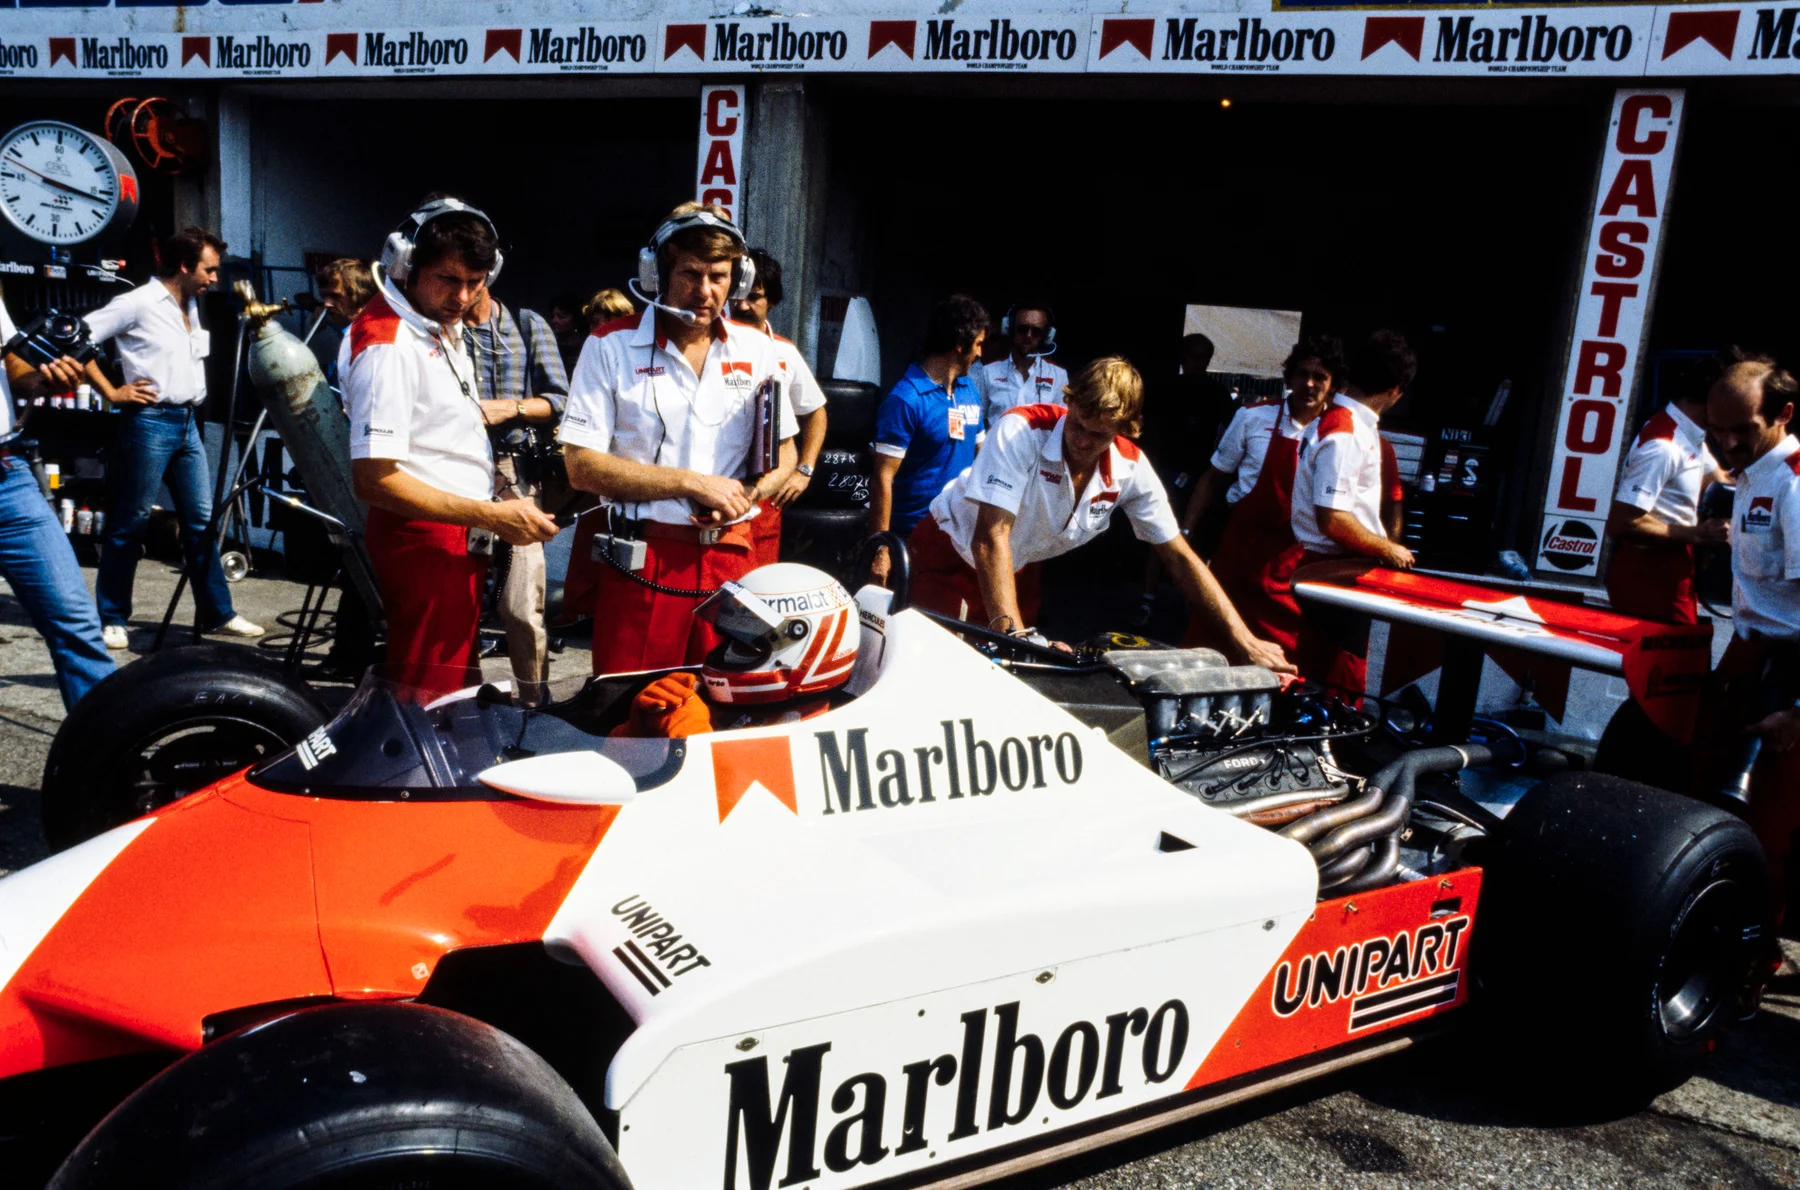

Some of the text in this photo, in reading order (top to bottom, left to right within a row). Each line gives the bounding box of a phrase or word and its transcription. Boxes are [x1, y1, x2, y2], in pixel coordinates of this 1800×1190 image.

[81, 37, 168, 69] Marlboro
[216, 36, 311, 68] Marlboro
[363, 32, 468, 66] Marlboro
[527, 27, 646, 63] Marlboro
[713, 23, 848, 61] Marlboro
[923, 20, 1077, 60] Marlboro
[1161, 18, 1335, 62] Marlboro
[1432, 15, 1632, 63] Marlboro
[55, 145, 64, 154] 60
[51, 213, 60, 222] 30
[1557, 95, 1671, 512] CASTROL
[824, 453, 856, 464] 287K
[1548, 536, 1598, 554] Castrol
[814, 718, 1083, 816] Marlboro
[1223, 757, 1259, 769] FORD
[611, 894, 711, 977] UNIPART
[1272, 915, 1470, 1019] UNIPART
[723, 999, 1190, 1190] Marlboro
